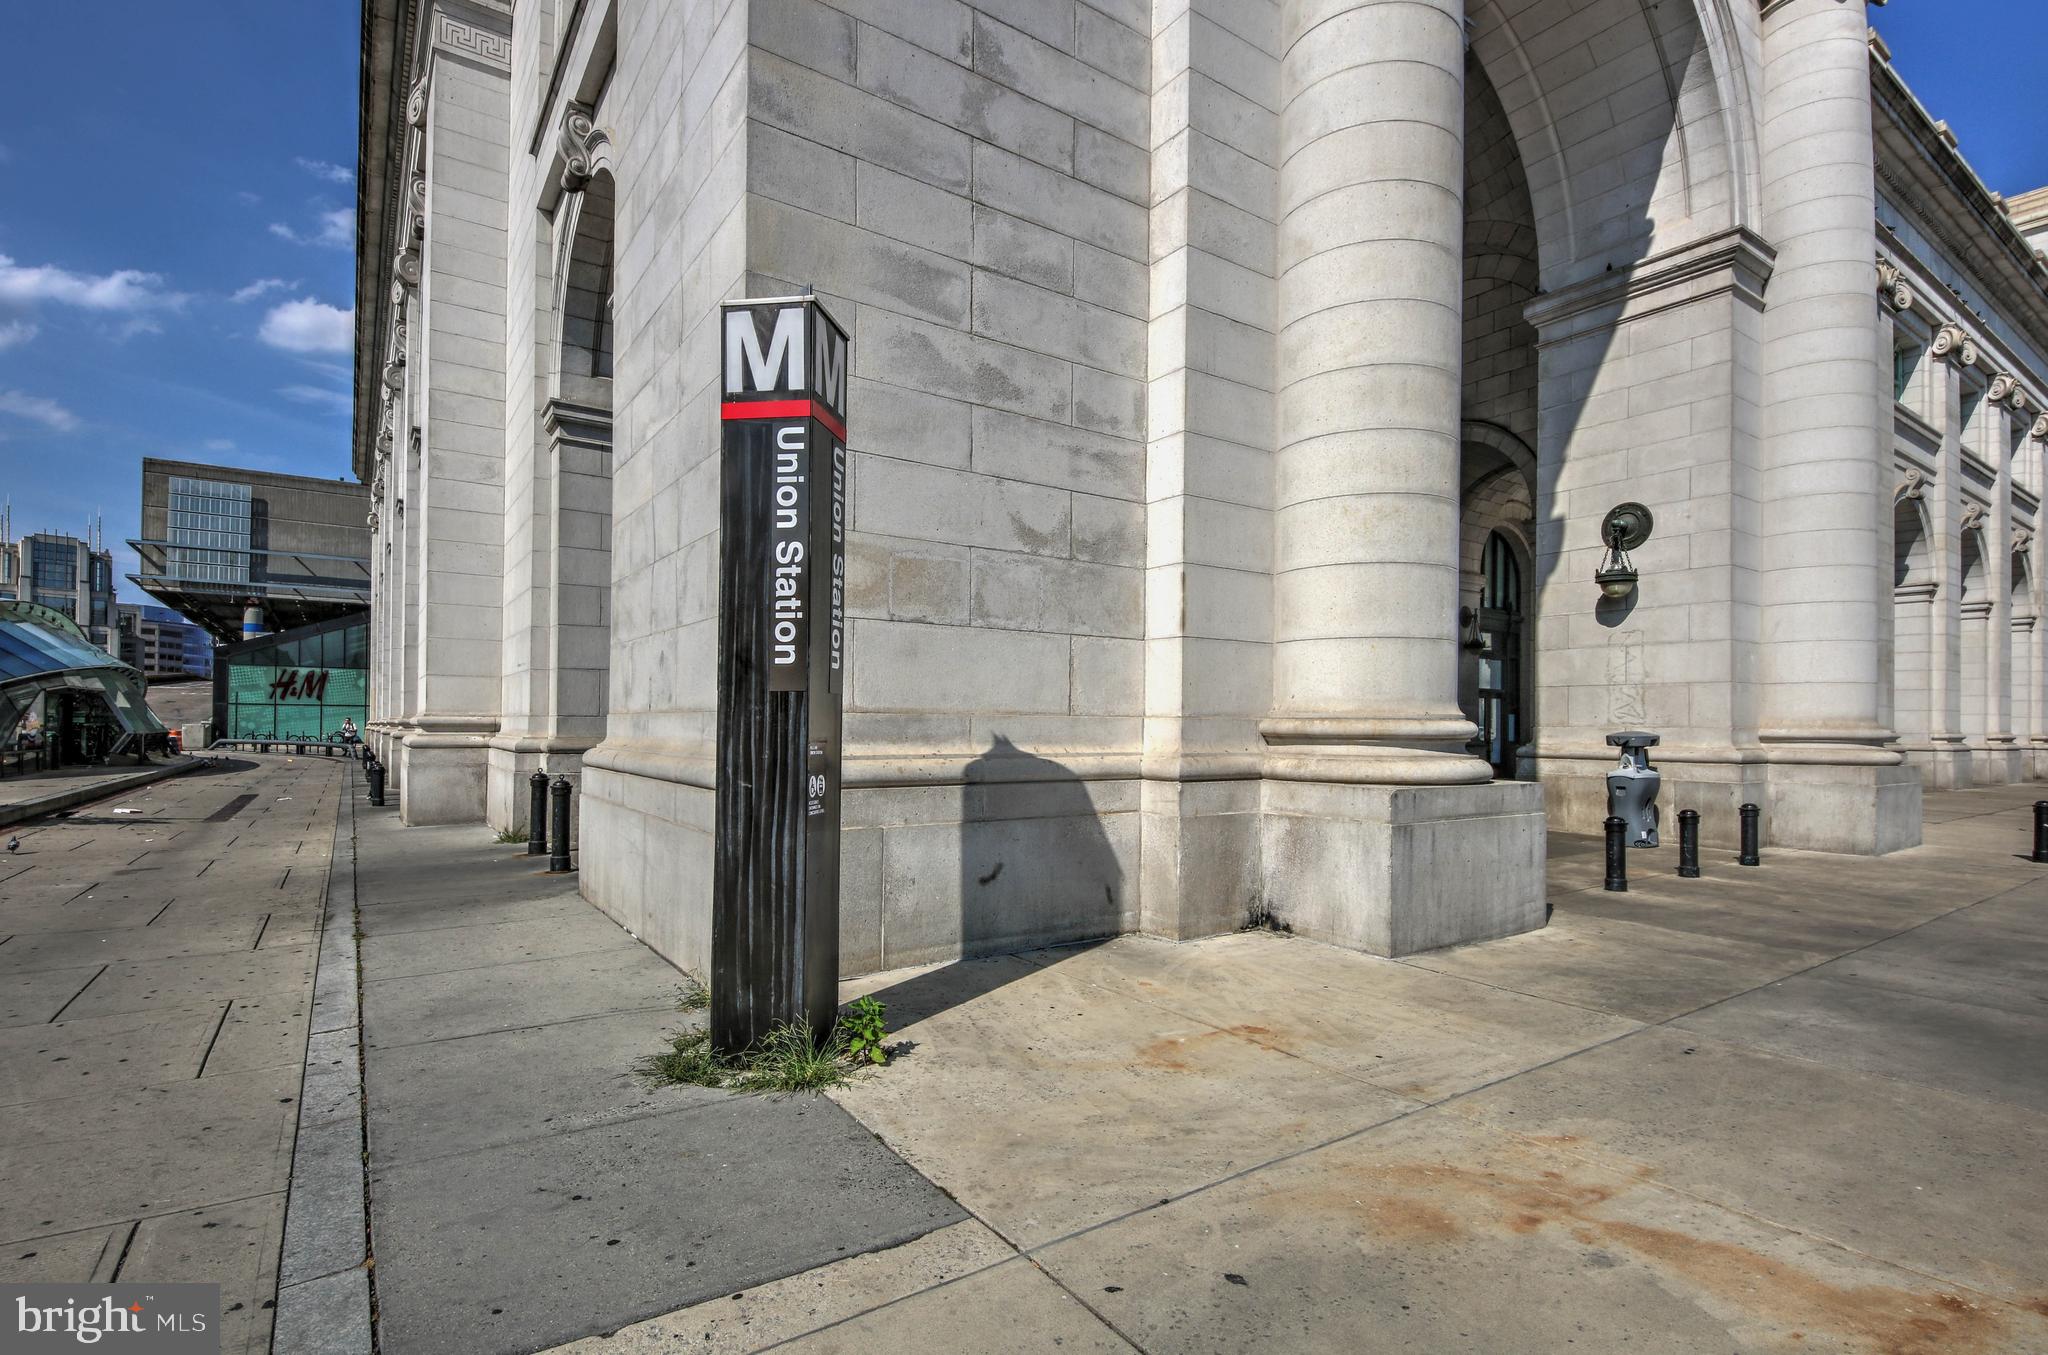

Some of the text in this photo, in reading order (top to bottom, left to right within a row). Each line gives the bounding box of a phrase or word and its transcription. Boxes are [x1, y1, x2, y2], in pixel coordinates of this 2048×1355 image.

[727, 308, 804, 392] M
[815, 311, 845, 417] M
[774, 427, 804, 665] Union Station
[831, 446, 844, 670] Union Station
[269, 669, 329, 701] H&M
